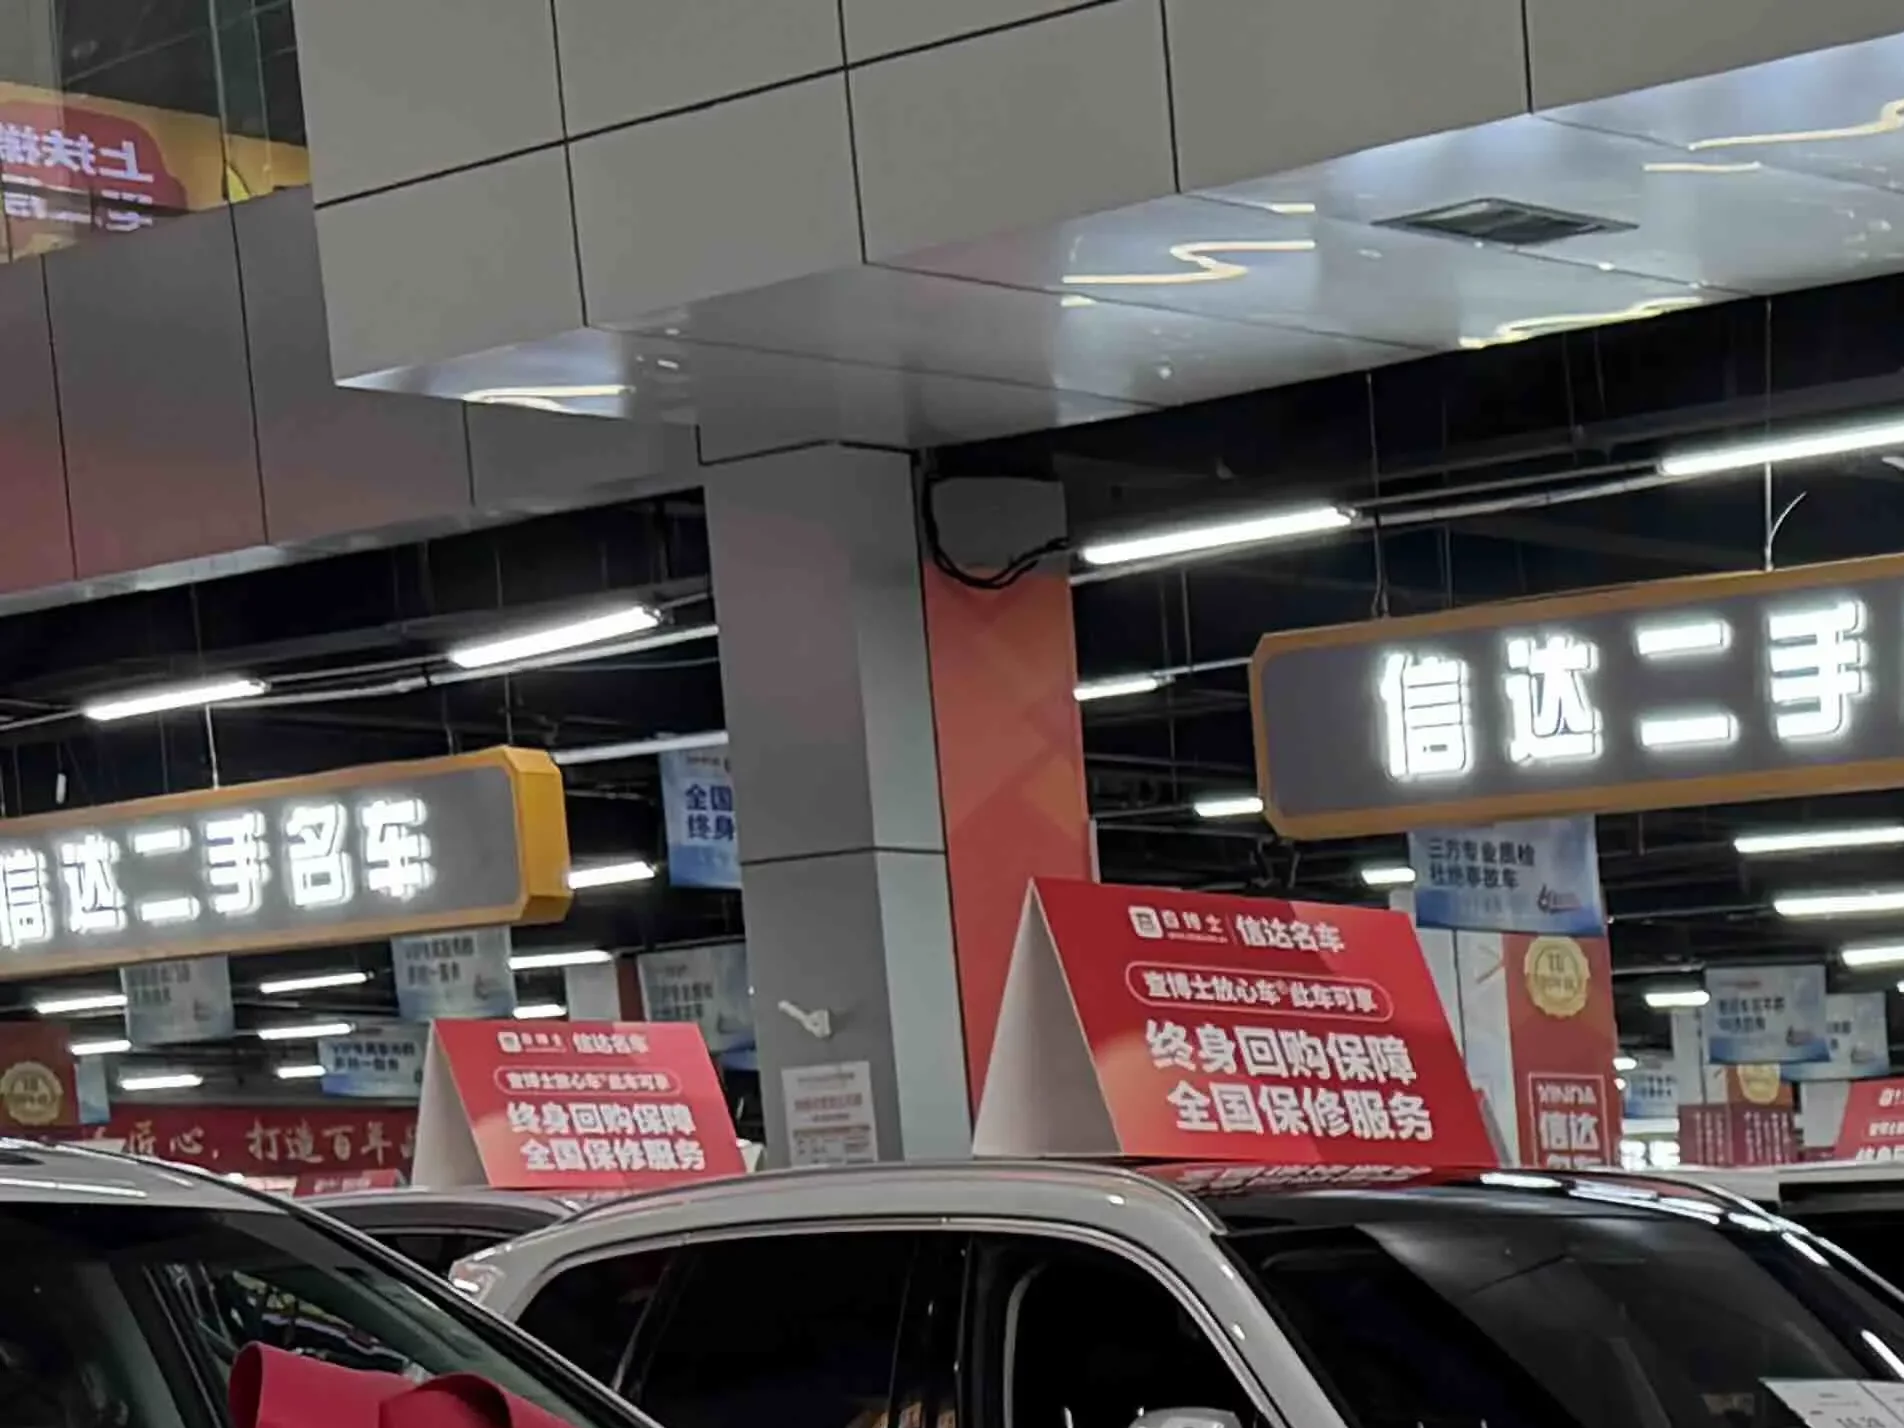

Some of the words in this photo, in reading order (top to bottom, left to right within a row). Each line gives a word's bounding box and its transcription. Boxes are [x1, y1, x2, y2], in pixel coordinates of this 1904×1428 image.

[0, 797, 435, 948] 信达二手名车
[1235, 913, 1347, 953] 信达名车
[1145, 1018, 1417, 1086] 终身回购保障
[506, 1101, 697, 1135] 终身回购保障
[1167, 1079, 1434, 1142] 全国保修服务
[1540, 1112, 1600, 1151] 信达
[82, 1116, 416, 1166] 匠心，打造百年
[520, 1137, 705, 1172] 全国保修服务
